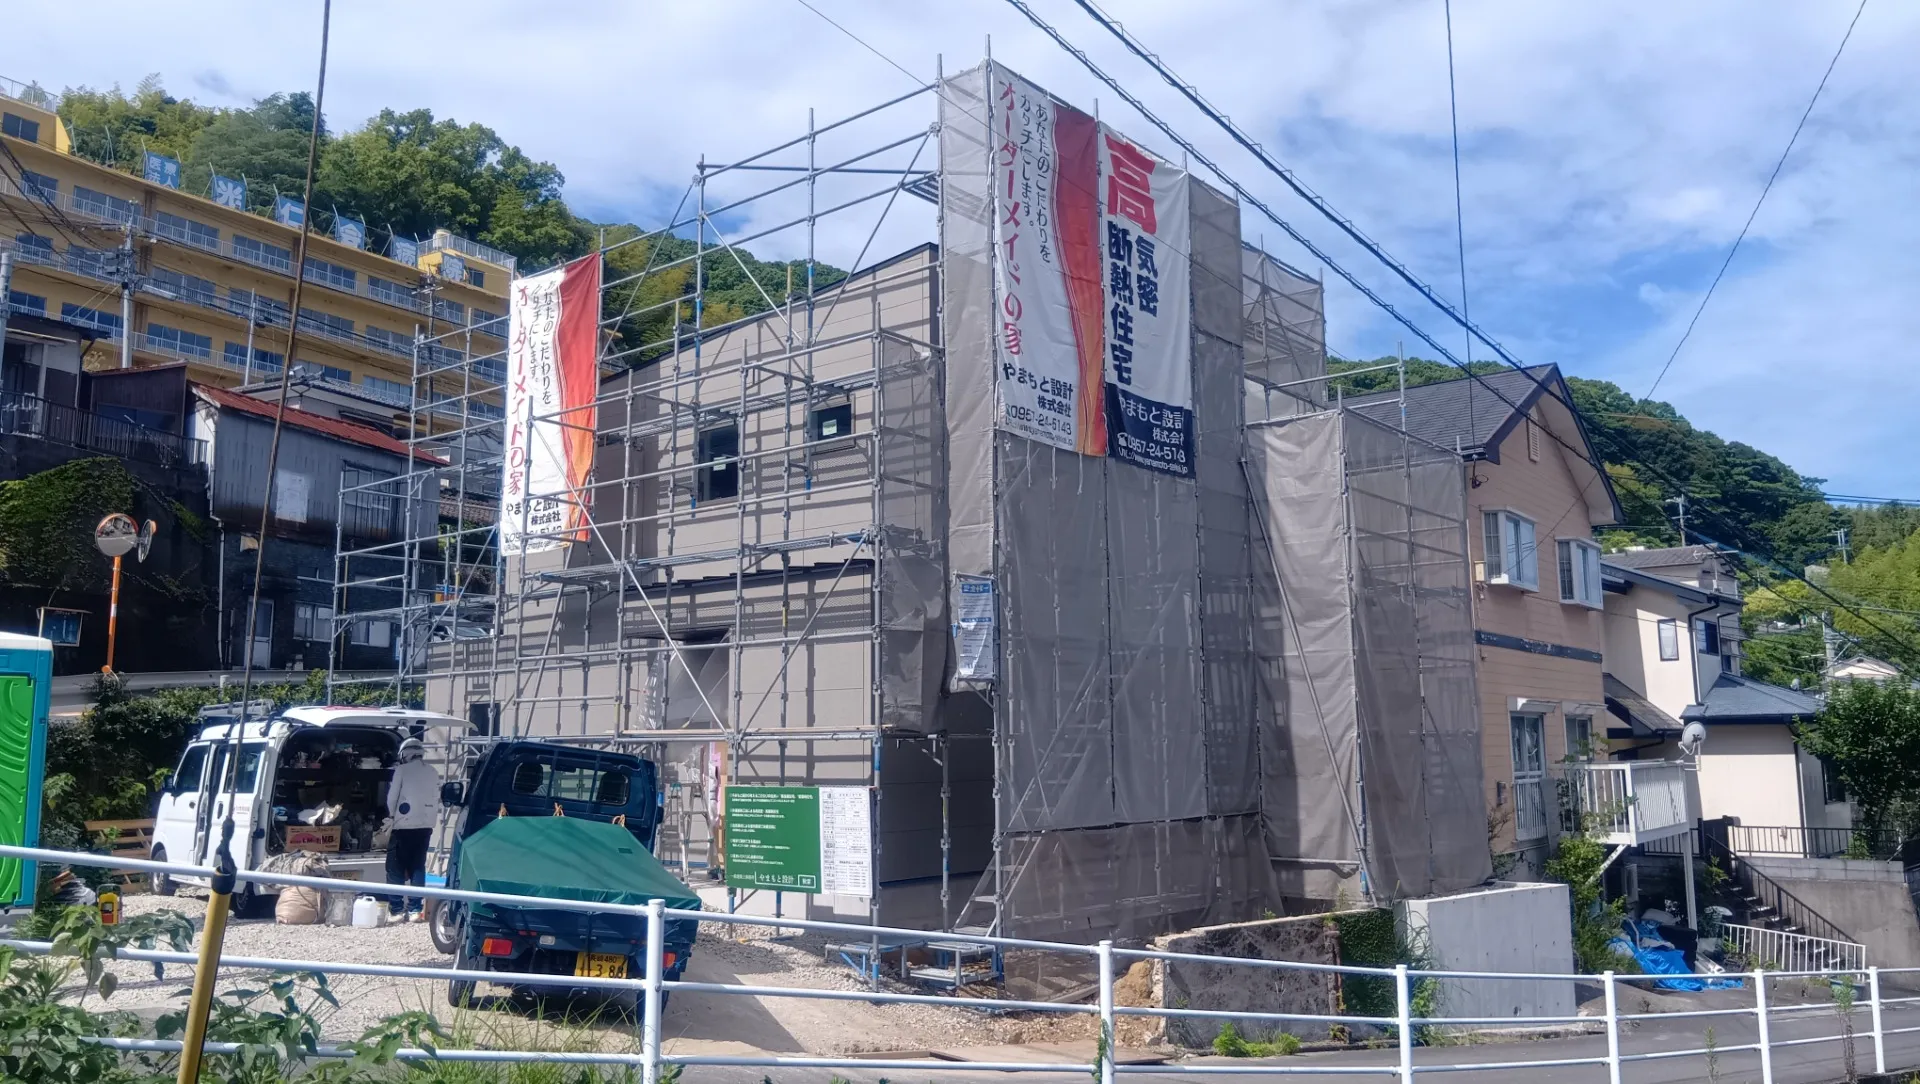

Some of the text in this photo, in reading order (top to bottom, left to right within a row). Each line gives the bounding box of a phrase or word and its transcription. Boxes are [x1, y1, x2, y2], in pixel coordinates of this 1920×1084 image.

[1019, 94, 1035, 228] カタチにします。
[1035, 103, 1051, 263] あなたのこだわりを
[1104, 132, 1158, 235] 高
[998, 80, 1024, 356] オーダーメイドの家
[1107, 221, 1133, 387] 断熱住宅
[1134, 235, 1159, 318] 気密
[508, 285, 528, 496] オーダーメイドの家
[1002, 362, 1074, 401] やまもと設計
[1037, 394, 1072, 418] 株式会社
[1119, 393, 1184, 429] やまもと設計
[506, 497, 559, 516] やまと設計
[531, 510, 561, 526] 株式会社
[759, 874, 795, 884] やまもと設計
